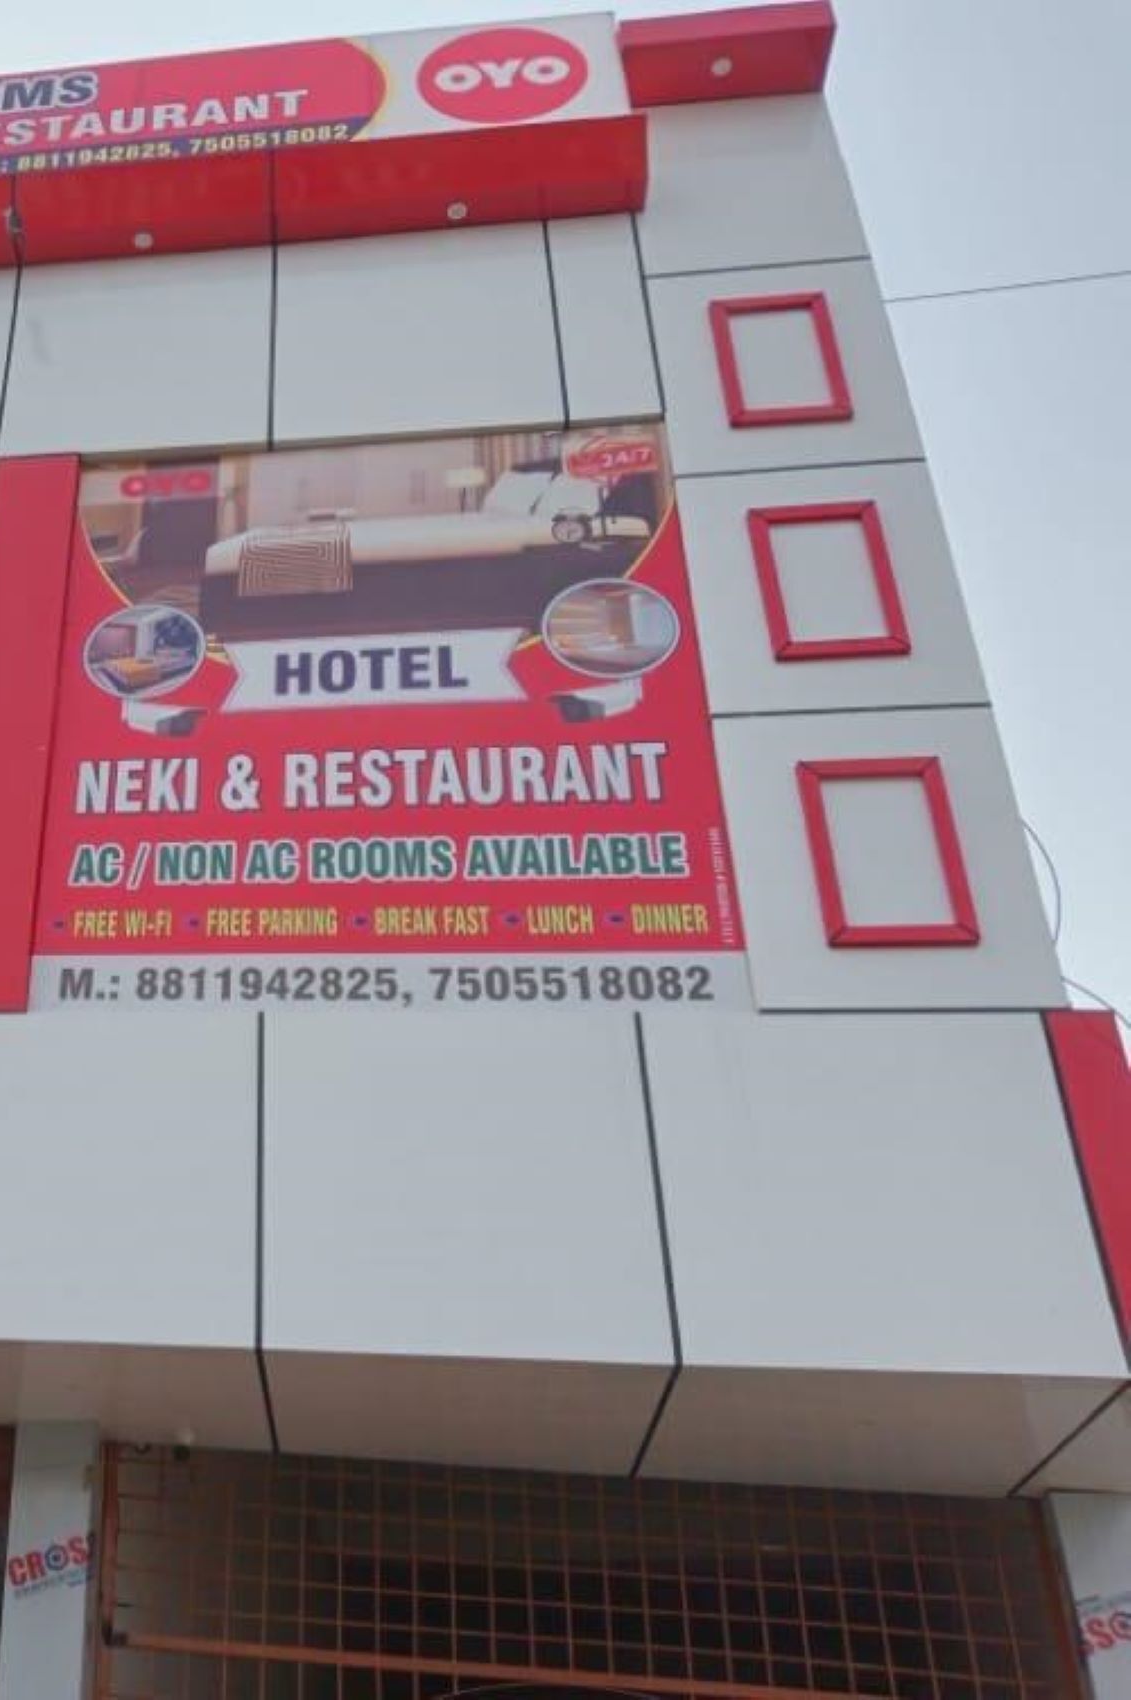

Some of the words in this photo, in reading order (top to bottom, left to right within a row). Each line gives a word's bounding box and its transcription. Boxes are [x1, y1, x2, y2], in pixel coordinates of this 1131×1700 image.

[433, 55, 570, 94] OYO
[189, 124, 349, 154] 7505518082
[273, 645, 468, 695] HOTEL
[75, 757, 198, 814] NEKI
[221, 754, 261, 810] &
[284, 742, 667, 808] RESTAURANT
[68, 844, 124, 886] AC
[126, 842, 151, 891] /
[154, 841, 237, 885] NON
[243, 839, 299, 884] AC
[308, 836, 456, 883] ROOMS
[464, 832, 689, 880] AVAILABLE
[73, 909, 118, 938] FREE
[125, 907, 172, 936] WI-FI
[206, 908, 252, 936] FREE
[259, 906, 337, 936] PARKING
[373, 905, 437, 936] BREAK
[445, 904, 491, 935] FAST
[527, 904, 594, 934] LUNCH
[632, 903, 708, 934] DINNER
[59, 968, 120, 1000] M.:
[136, 966, 413, 1007] 8811942825,
[429, 966, 714, 1001] 7505518082
